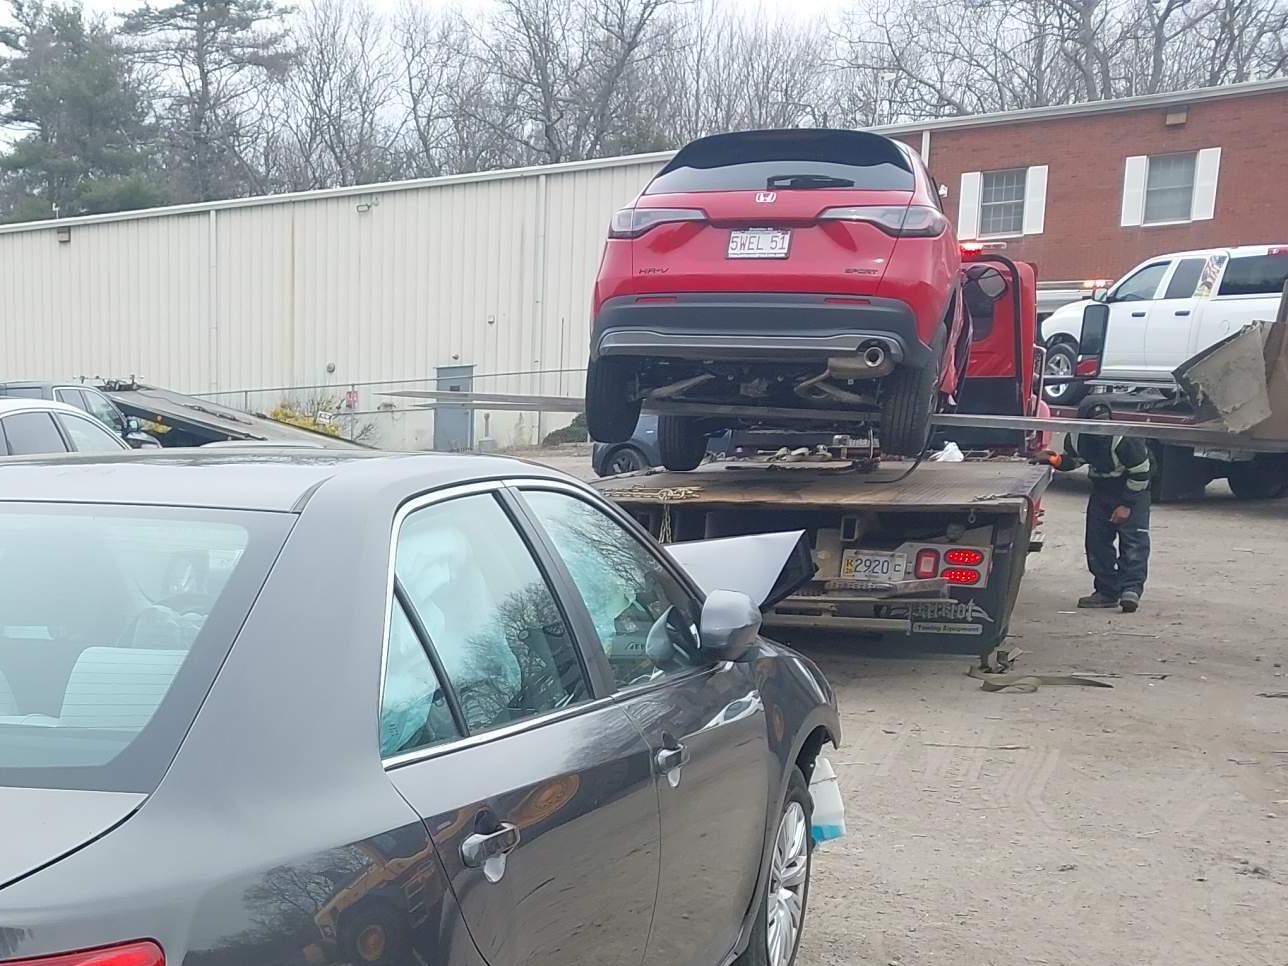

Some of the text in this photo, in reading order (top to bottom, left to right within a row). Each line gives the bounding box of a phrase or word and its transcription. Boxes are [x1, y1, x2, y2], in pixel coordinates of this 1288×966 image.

[730, 235, 786, 251] 5WEL 51
[638, 267, 670, 275] HR-V
[844, 267, 879, 275] SPORT
[854, 558, 890, 575] 2920
